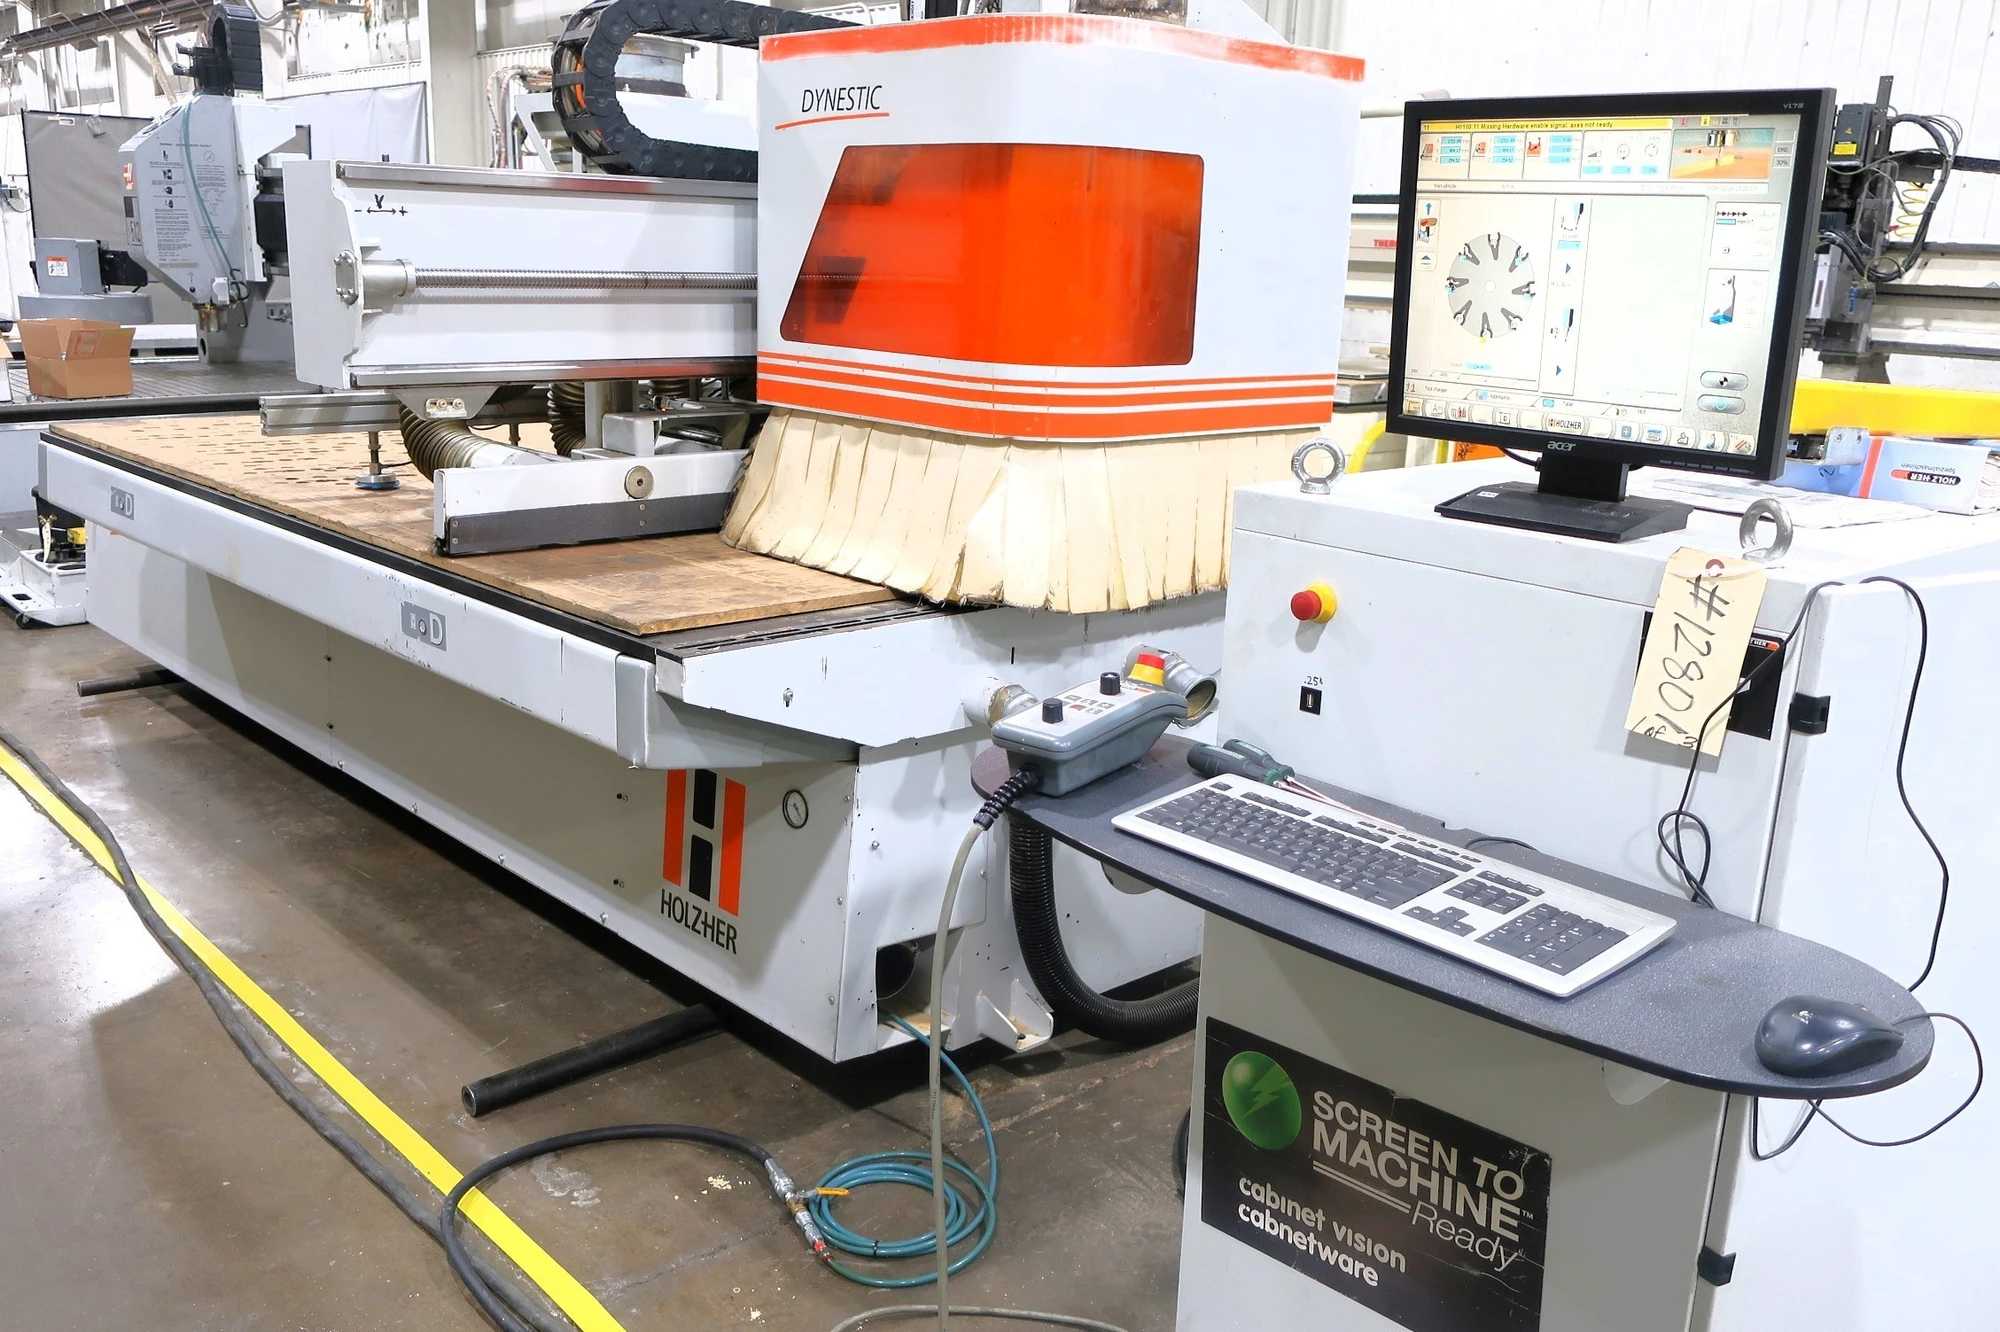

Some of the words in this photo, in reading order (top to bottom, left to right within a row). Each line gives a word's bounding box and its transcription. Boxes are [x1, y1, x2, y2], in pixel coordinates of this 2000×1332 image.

[801, 85, 882, 113] DYNESTIC
[1547, 440, 1576, 451] acer
[1312, 1090, 1458, 1176] SCREEN
[1472, 1156, 1525, 1200] TO
[1238, 1176, 1326, 1231] cabinet
[1332, 1219, 1406, 1272] vision
[1238, 1203, 1379, 1287] cabnetware
[1410, 1200, 1520, 1271] Ready
